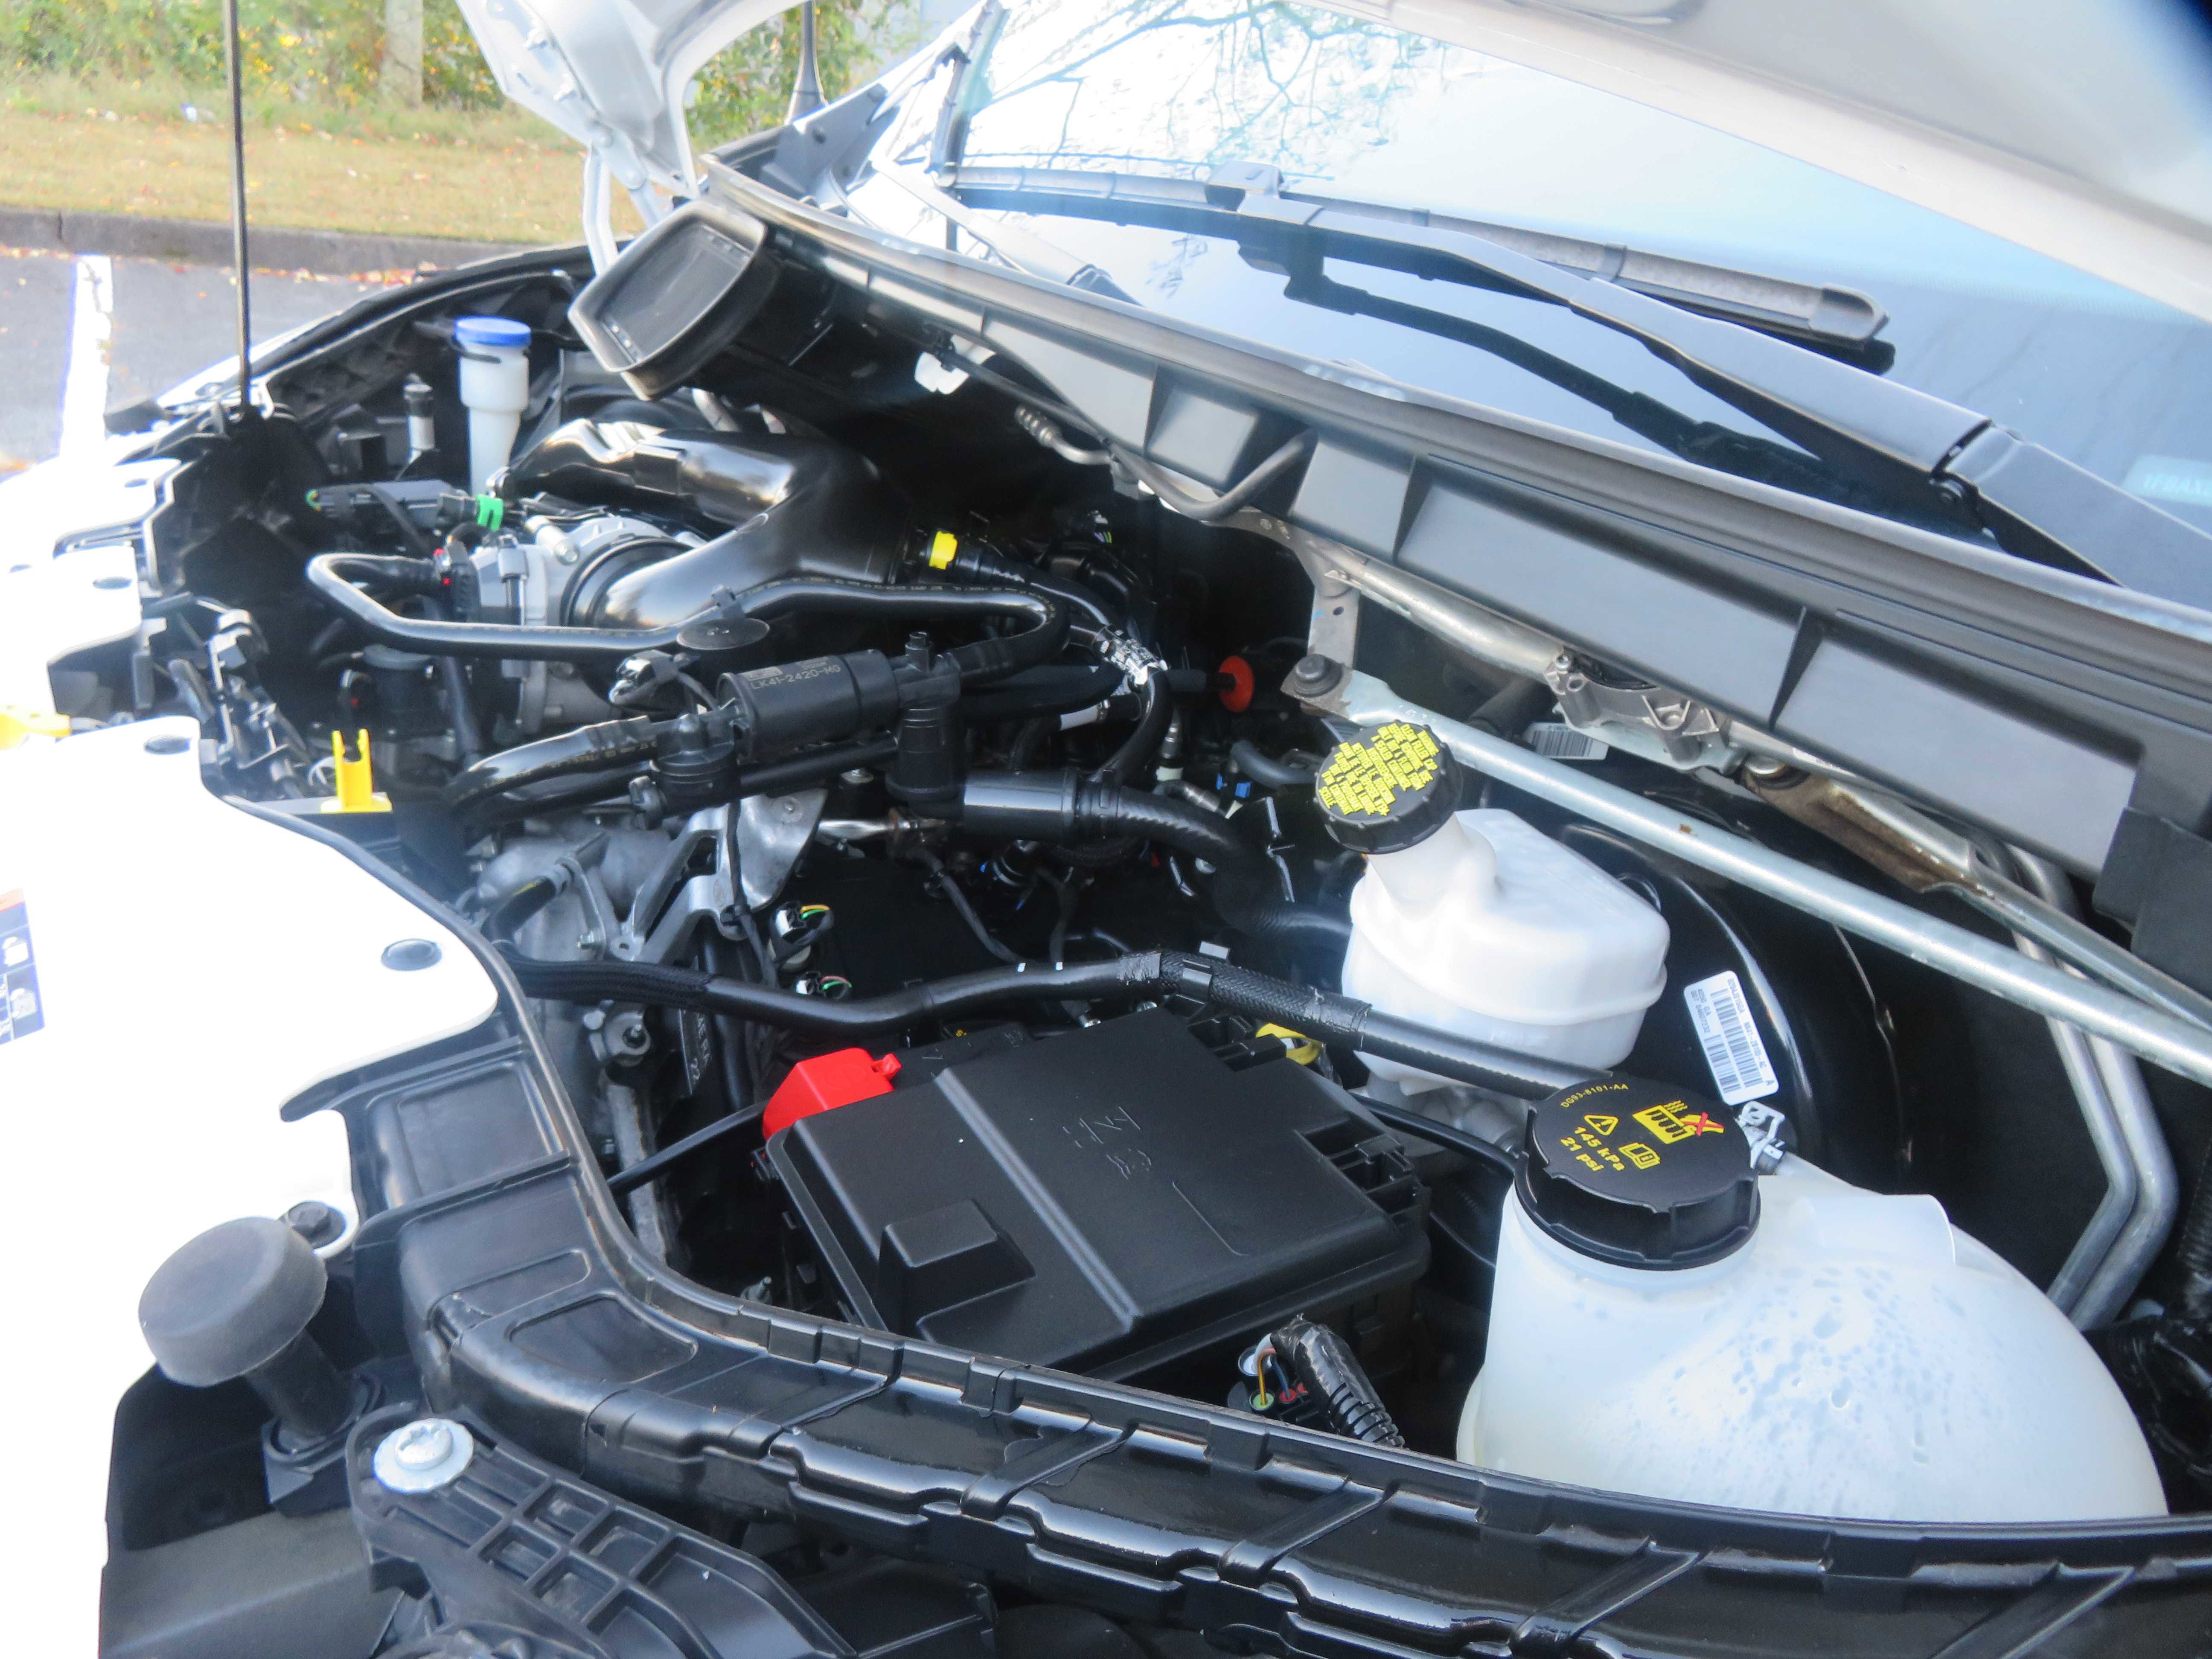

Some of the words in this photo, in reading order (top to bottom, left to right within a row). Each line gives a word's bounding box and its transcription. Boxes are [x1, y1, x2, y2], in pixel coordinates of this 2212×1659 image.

[1339, 742, 1356, 759] AVANT
[1374, 740, 1394, 761] SEALED
[1377, 726, 1394, 740] ONLY
[1386, 739, 1400, 751] DOT
[1397, 756, 1414, 774] FLUID
[1409, 772, 1426, 791] FROM
[1387, 723, 1407, 744] BEFORE
[1418, 769, 1434, 783] USE
[1400, 724, 1418, 742] CLEAN
[1412, 740, 1430, 760] FILLER
[1423, 758, 1438, 770] CAP
[1328, 763, 1343, 776] DOT
[1349, 757, 1361, 768] DE
[1353, 766, 1366, 776] LE
[1367, 768, 1379, 778] LE
[1560, 1083, 1629, 1108] DG93-8101-AA
[1560, 1137, 1583, 1151] 21
[1576, 1153, 1605, 1171] psi
[1575, 1126, 1602, 1147] 145
[1597, 1147, 1625, 1171] kPa
